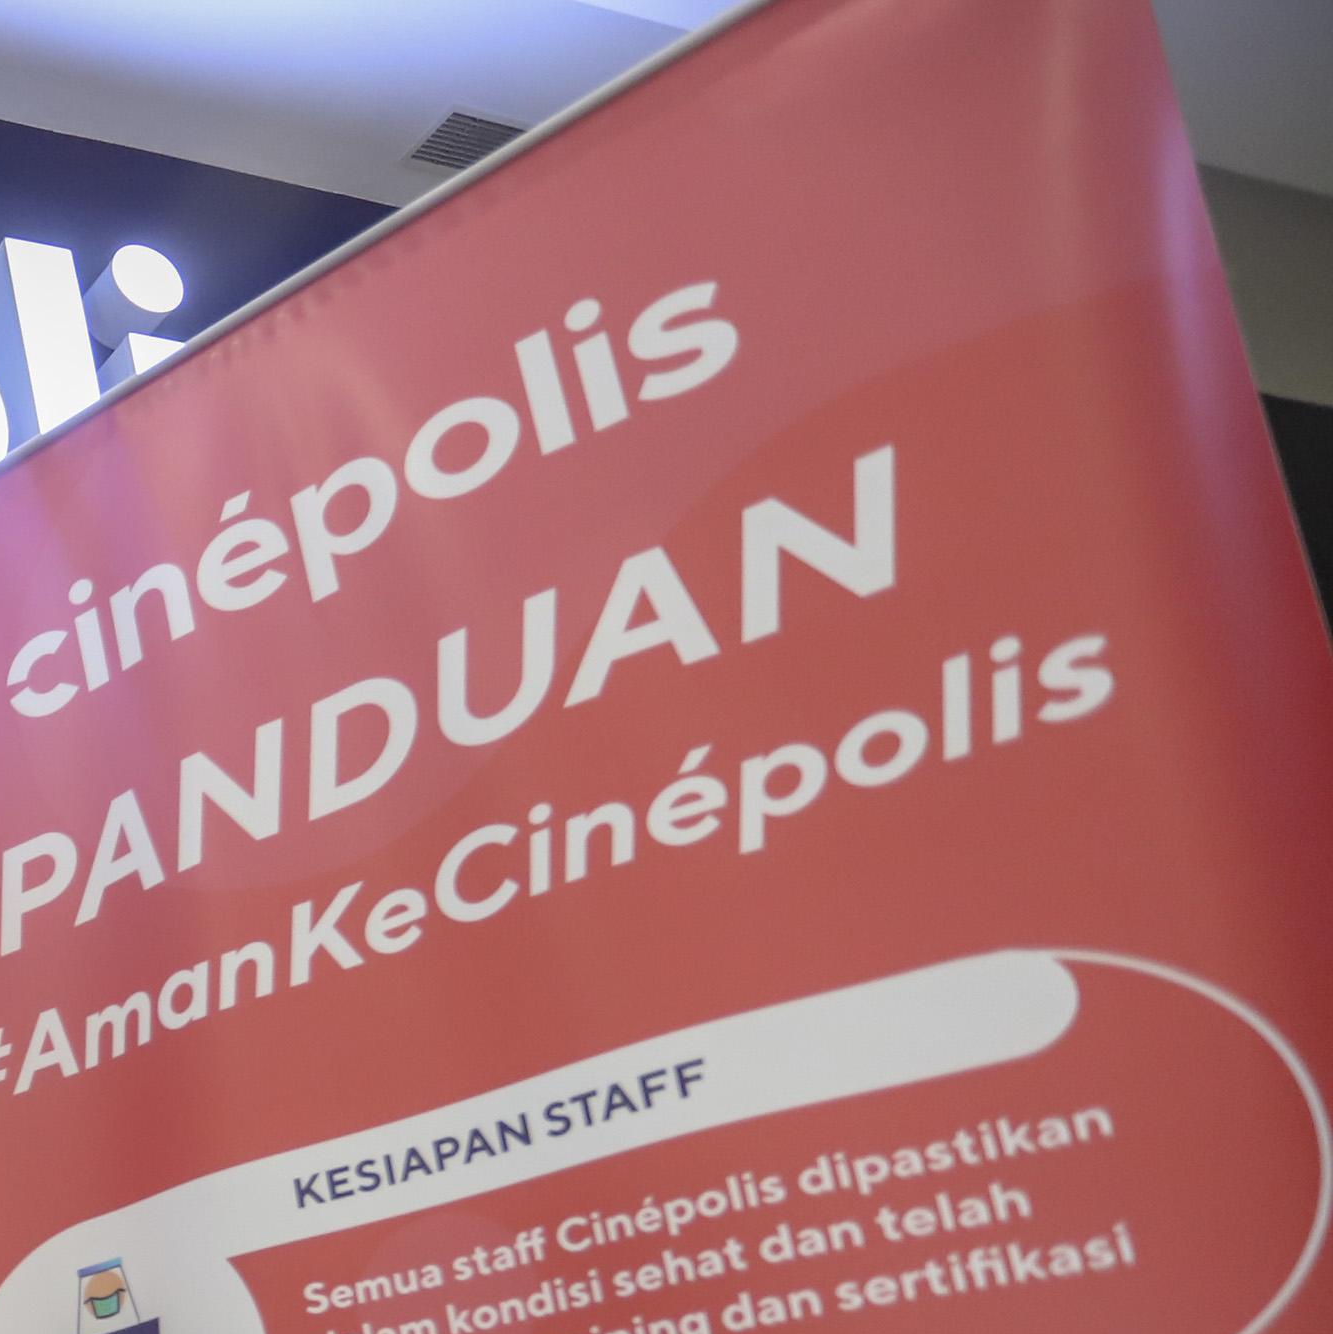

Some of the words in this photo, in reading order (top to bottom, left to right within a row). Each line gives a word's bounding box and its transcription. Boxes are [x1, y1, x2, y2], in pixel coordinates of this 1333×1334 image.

[7, 281, 739, 718] cinépolis
[0, 444, 896, 956] PANDUAN
[293, 1113, 533, 1209] KESIAPAN
[543, 1059, 707, 1139] STAFF
[303, 1263, 443, 1315] Semua
[452, 1226, 548, 1282] staff
[557, 1171, 787, 1255] Cinépolis
[799, 1104, 1115, 1197] dipastikan
[612, 1235, 747, 1296] sehat
[759, 1214, 864, 1265] dan
[876, 1182, 1033, 1242] telah
[722, 1285, 823, 1333] dan
[837, 1222, 1136, 1311] sertifikasi
